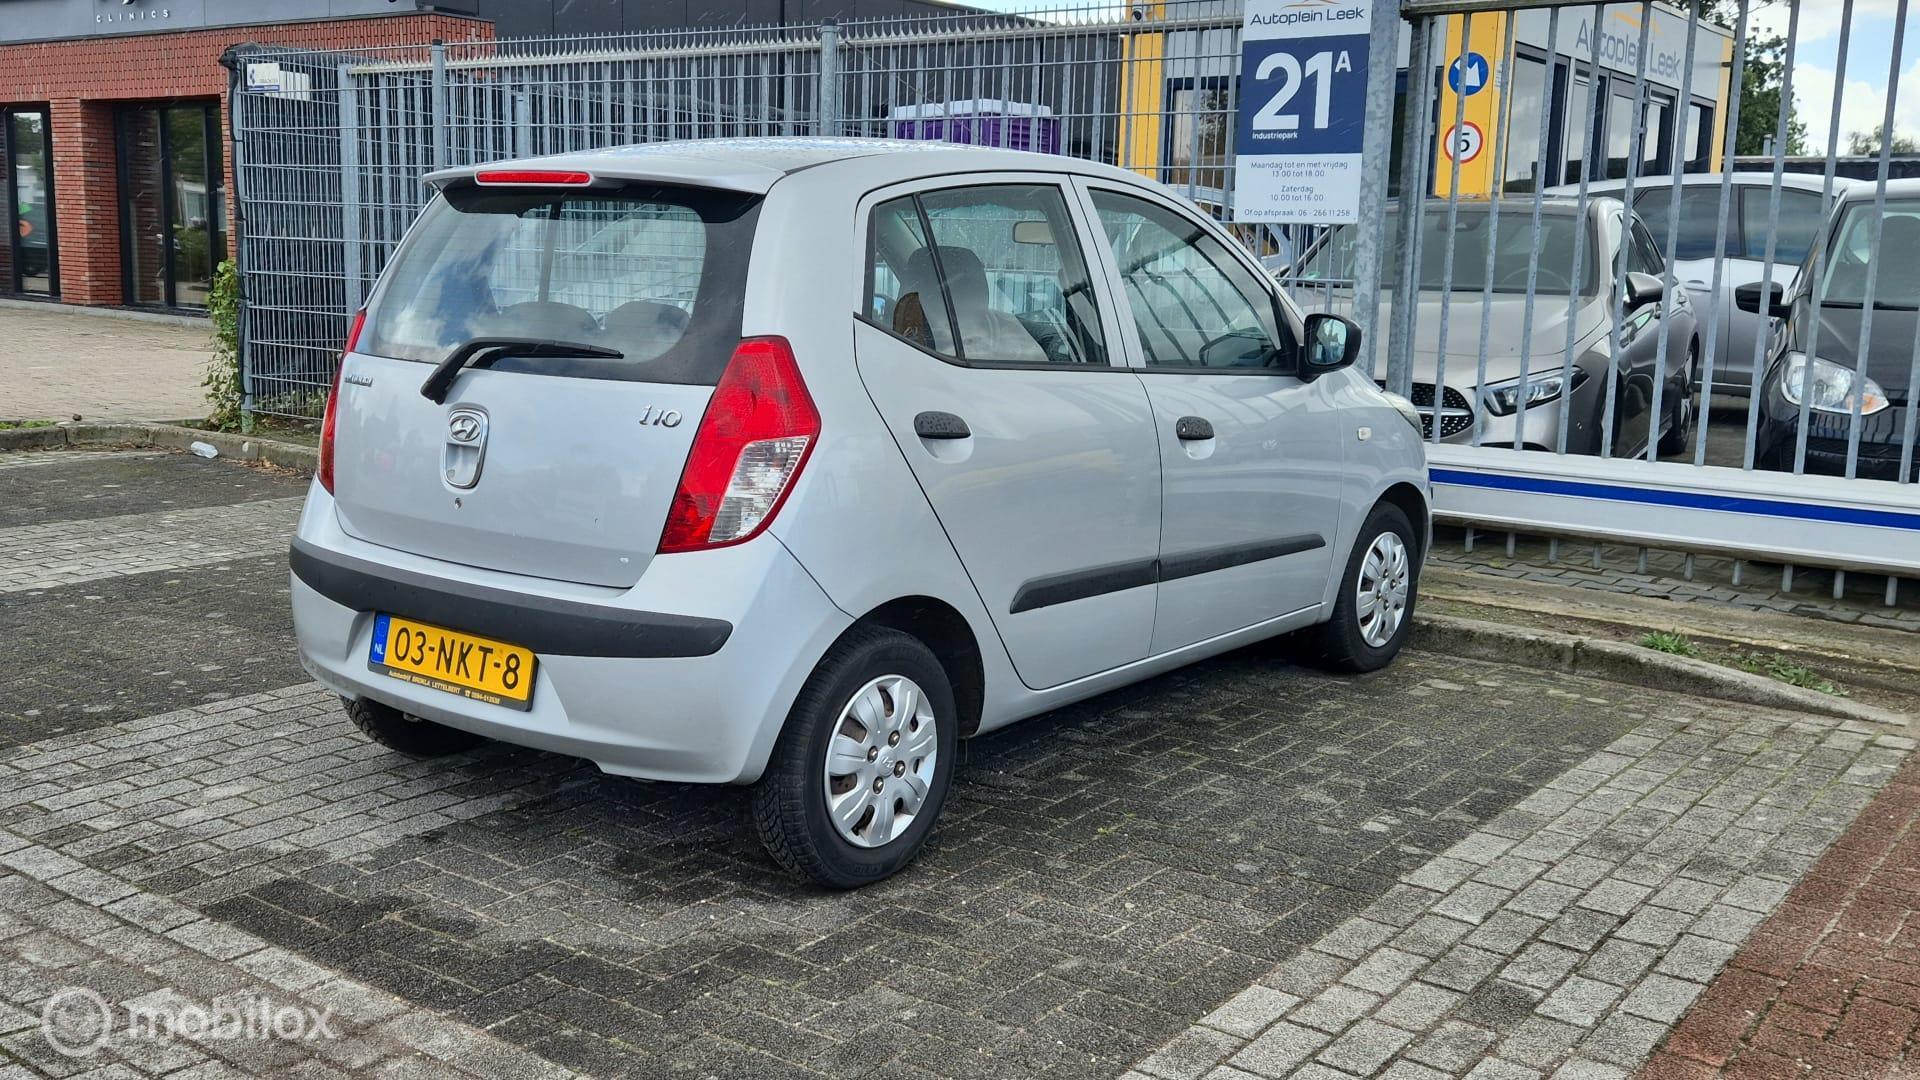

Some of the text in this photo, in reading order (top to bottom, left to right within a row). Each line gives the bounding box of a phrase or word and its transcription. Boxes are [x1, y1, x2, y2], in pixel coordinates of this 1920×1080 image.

[96, 9, 170, 23] CLINICS
[1250, 7, 1365, 26] Autoplein Leek
[1649, 42, 1681, 81] Leek
[1250, 161, 1283, 171] Maandag
[1284, 161, 1296, 169] tot
[1306, 161, 1321, 169] met
[1322, 161, 1348, 170] vrijdag
[1292, 170, 1304, 178] tot
[1281, 185, 1314, 194] Zaterdag
[1244, 208, 1254, 216] Of
[1297, 209, 1308, 217] 06
[1313, 209, 1328, 217] 266
[1329, 209, 1335, 217] 11
[1336, 209, 1351, 217] 258
[374, 642, 385, 656] NL
[394, 626, 521, 690] 03-NKT-8
